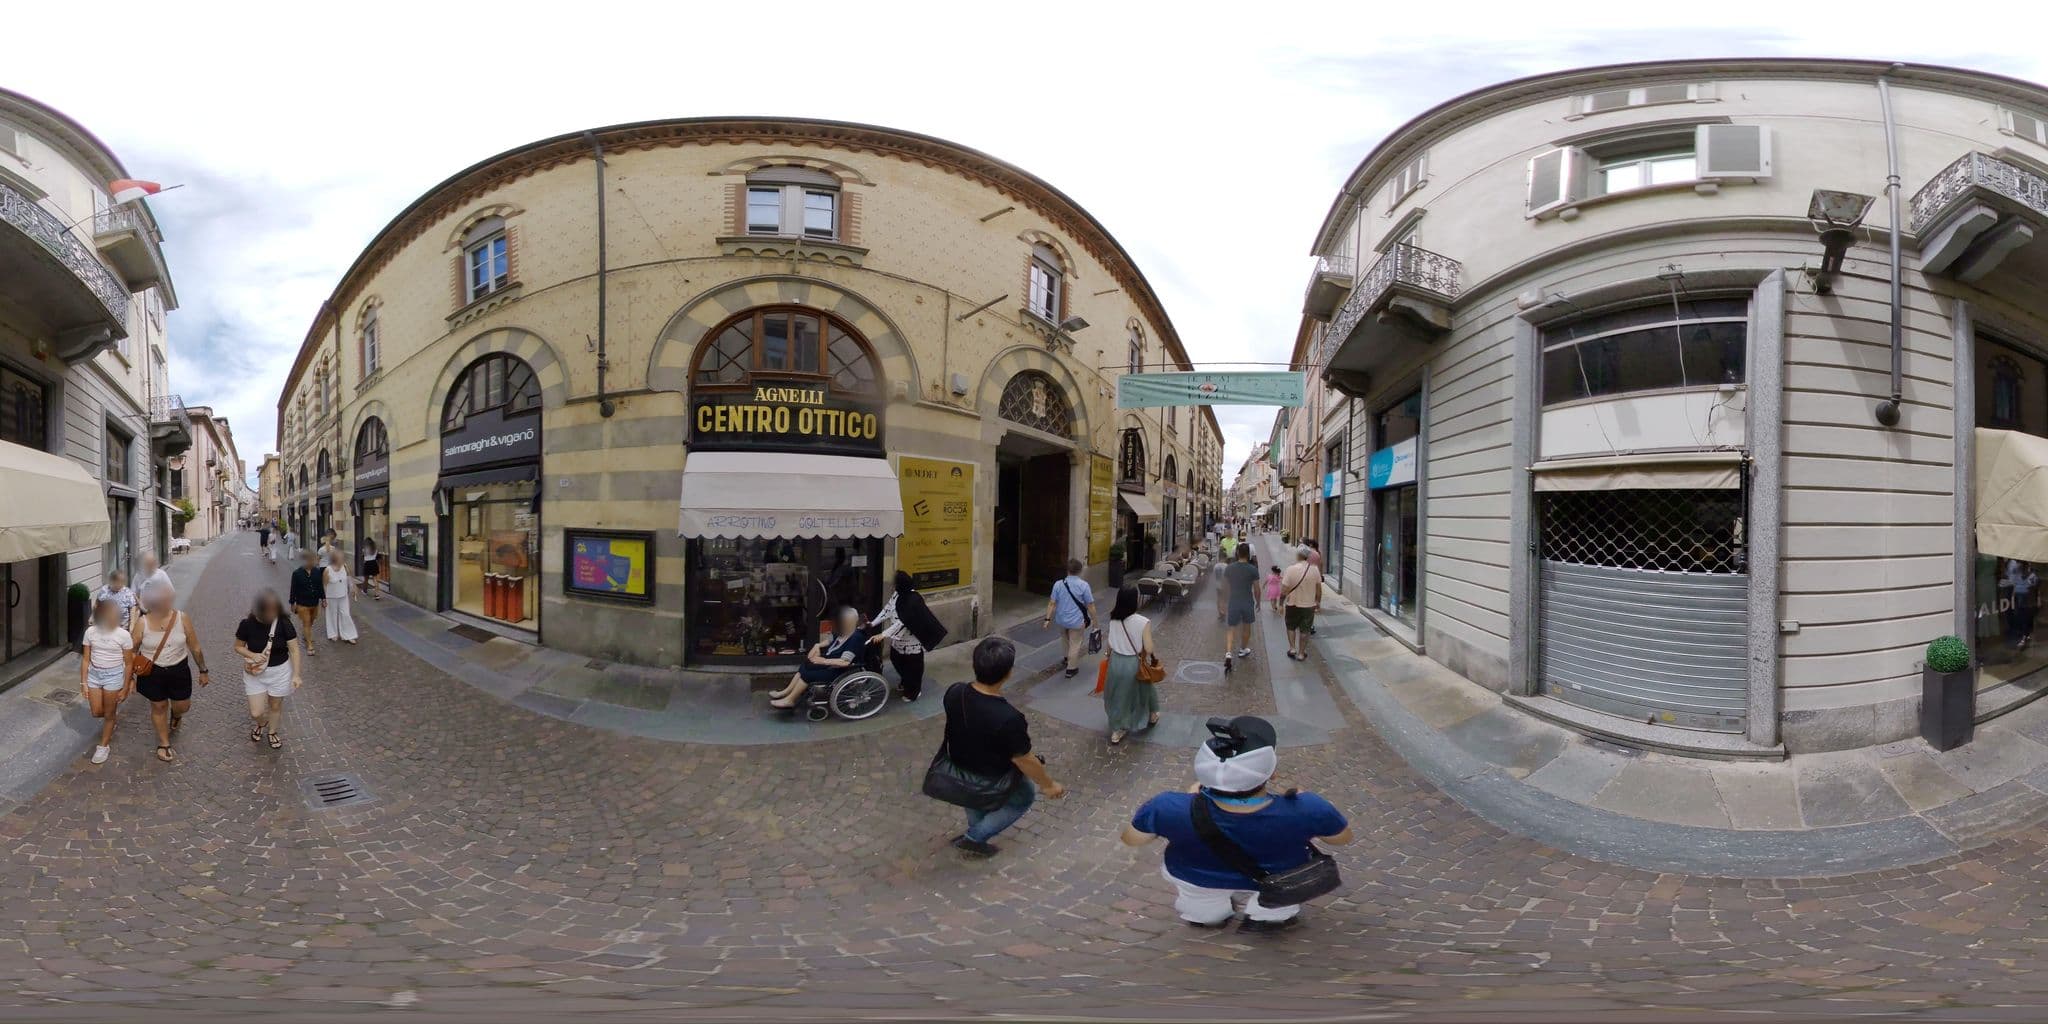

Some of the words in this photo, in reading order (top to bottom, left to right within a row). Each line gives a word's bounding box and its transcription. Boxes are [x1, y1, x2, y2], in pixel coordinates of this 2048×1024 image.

[755, 387, 825, 405] AGNELLI
[697, 405, 790, 433] CENTRO
[798, 407, 877, 439] OTTICO
[706, 516, 777, 530] ARROTINO
[799, 516, 881, 530] COLTELLERIA
